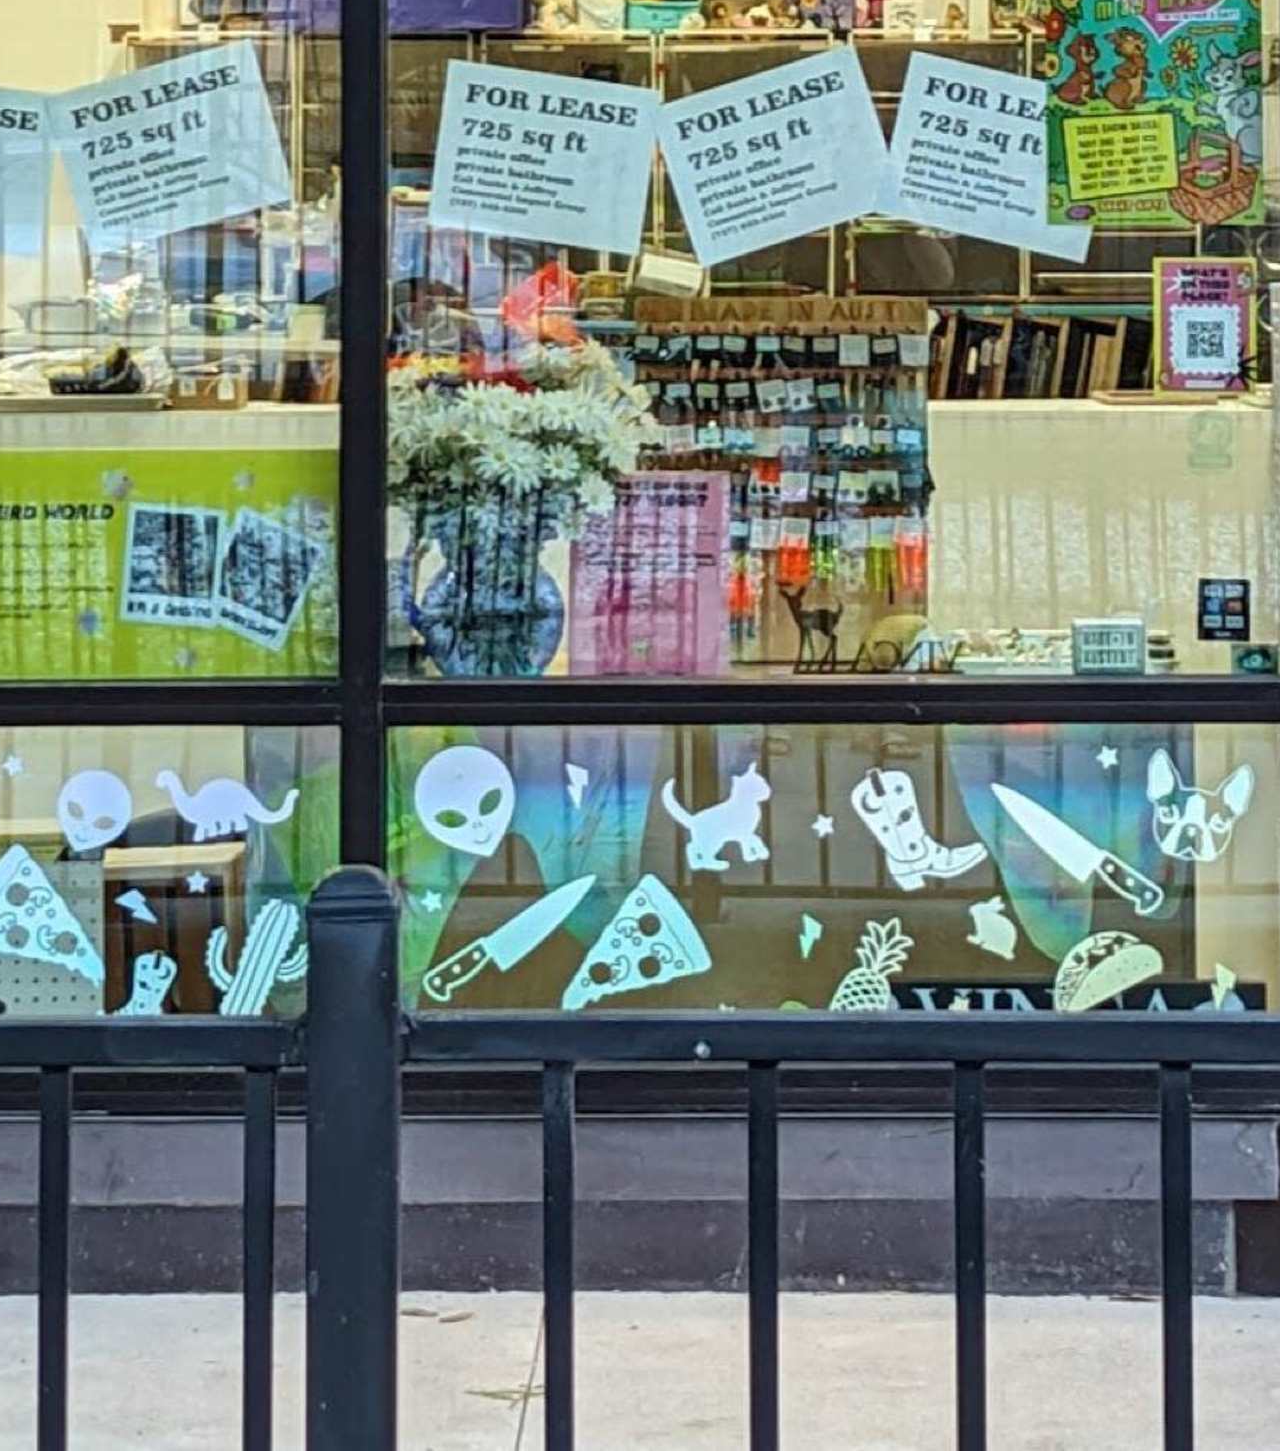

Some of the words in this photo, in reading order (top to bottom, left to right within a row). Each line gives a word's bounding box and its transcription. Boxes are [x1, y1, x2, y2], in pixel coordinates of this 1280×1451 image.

[72, 95, 136, 129] FOR
[141, 65, 240, 109] LEASE
[466, 83, 530, 111] FOR
[539, 95, 638, 127] LEASE
[676, 105, 741, 141] FOR
[746, 71, 845, 118] LEASE
[925, 77, 989, 109] FOR
[83, 131, 133, 160] 725
[141, 122, 176, 143] sq
[181, 108, 206, 131] ft
[463, 118, 512, 141] 725
[522, 131, 554, 154] sq
[565, 131, 588, 153] ft
[688, 141, 738, 170] 725
[747, 130, 782, 153] sq
[787, 116, 812, 141] ft
[911, 138, 960, 156] private
[920, 110, 968, 137] 725
[978, 127, 1011, 154] sq
[1021, 132, 1043, 155] ft
[455, 161, 504, 175] private
[458, 147, 505, 160] private
[909, 153, 956, 170] private
[696, 169, 741, 192] private
[700, 184, 746, 207] private
[44, 503, 115, 520] WORLD
